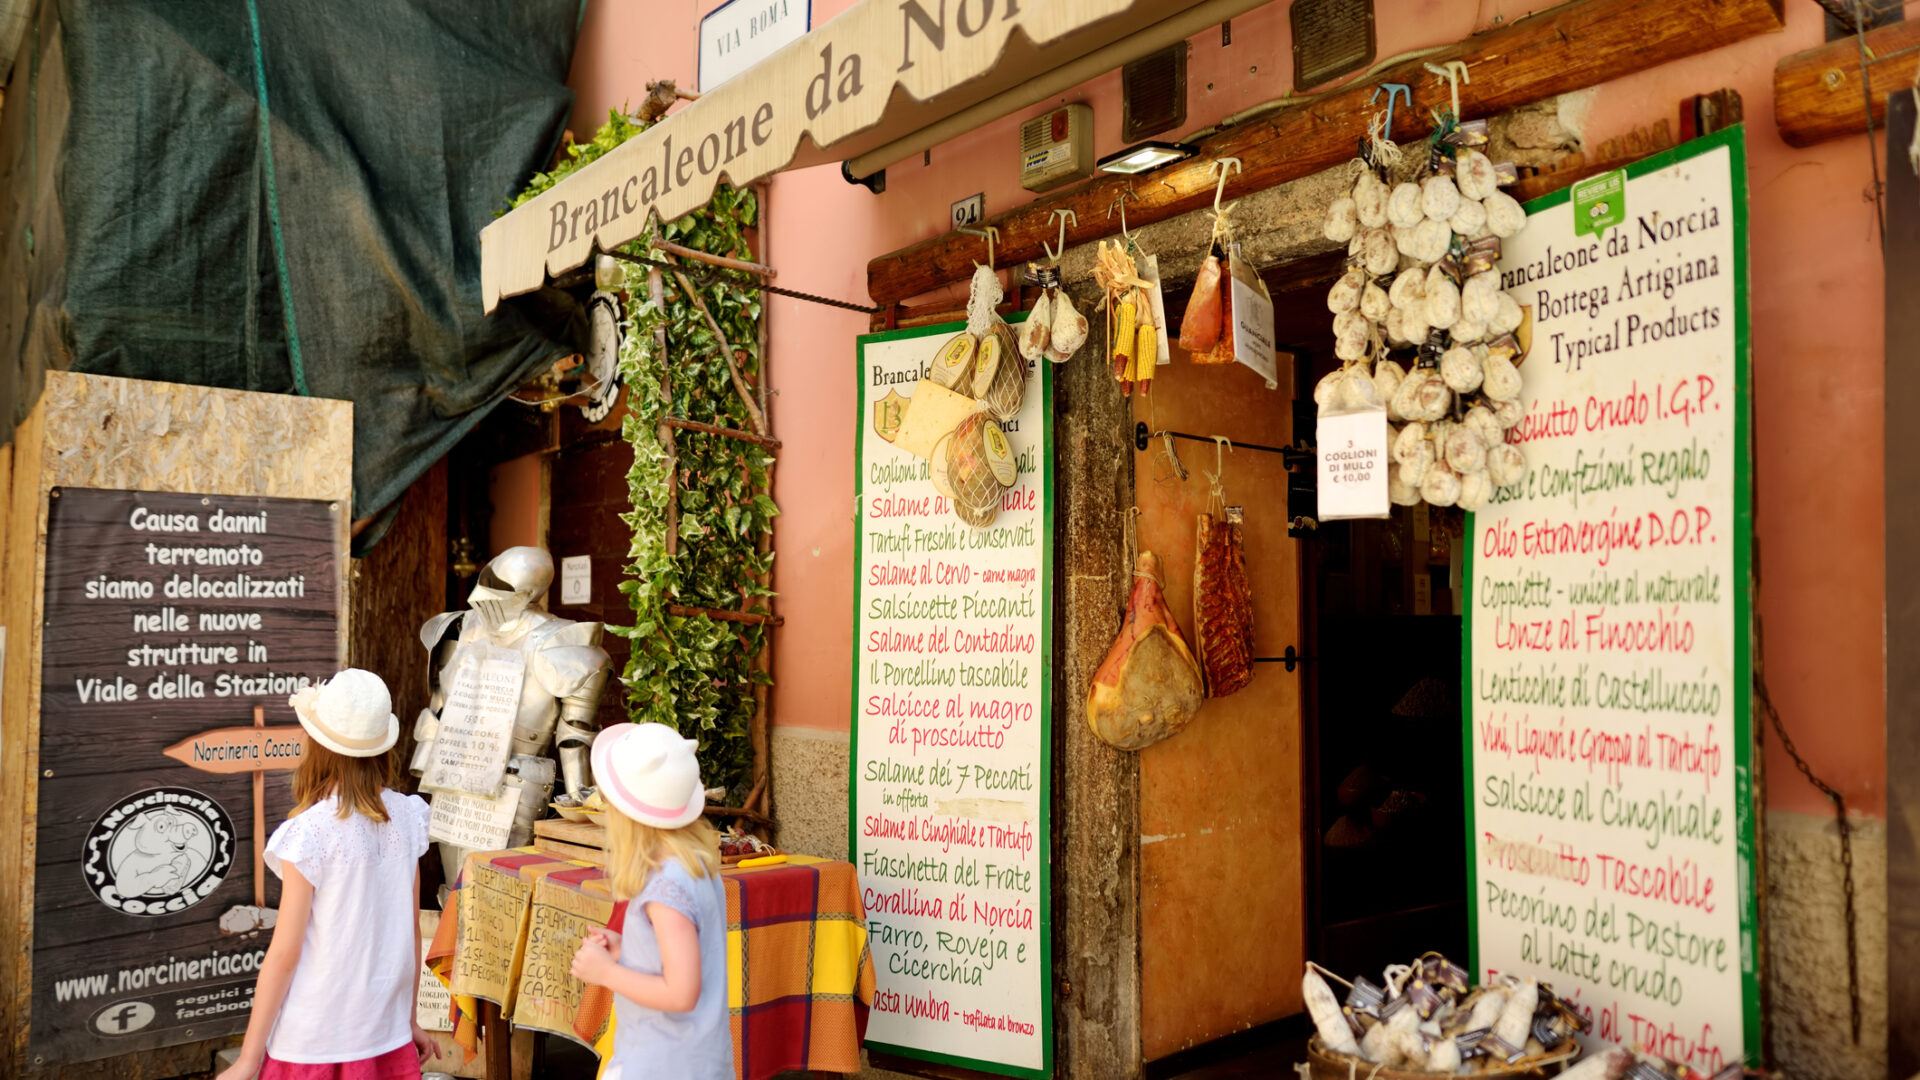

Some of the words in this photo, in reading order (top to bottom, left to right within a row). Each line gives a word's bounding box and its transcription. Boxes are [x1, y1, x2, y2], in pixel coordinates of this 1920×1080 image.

[716, 27, 742, 58] VIA
[750, 1, 789, 40] ROMA
[547, 102, 774, 252] Brancaleone
[805, 42, 864, 120] da
[1500, 243, 1599, 291] rancaleone
[1607, 228, 1629, 258] da
[1637, 197, 1720, 250] Norcia
[1537, 284, 1609, 323] Bottega
[1617, 251, 1720, 301] Artigiana
[1550, 319, 1620, 373] Typical
[1627, 304, 1720, 347] Products
[873, 361, 931, 386] Brancale
[1585, 380, 1648, 431] Crudo
[1656, 374, 1720, 427] I.G.P.
[1325, 449, 1377, 462] COGLIONI
[1347, 440, 1354, 448] 3
[871, 455, 918, 493] Coglioni
[920, 458, 931, 481] di
[1329, 463, 1342, 473] DI
[1343, 461, 1374, 472] MULO
[1343, 472, 1371, 483] 10,00
[1528, 470, 1535, 500] e
[1641, 437, 1710, 499] Regalo
[130, 507, 199, 534] Causa
[208, 509, 267, 534] danni
[870, 493, 929, 518] Salame
[935, 496, 950, 515] al
[145, 542, 263, 566] terremoto
[869, 523, 912, 561] Tartufi
[915, 521, 957, 553] Freschi
[959, 531, 965, 550] e
[969, 518, 1035, 551] Conservati
[1484, 517, 1517, 558] Olio
[1524, 506, 1642, 566] Extravergine
[1648, 506, 1716, 546] D.O.P.
[85, 576, 154, 600] siamo
[164, 574, 305, 599] delocalizzati
[868, 560, 917, 586] Salame
[920, 558, 933, 585] al
[936, 561, 970, 585] Cervo
[982, 568, 1005, 583] carne
[1007, 567, 1036, 589] magra
[1570, 569, 1620, 605] uniche
[1625, 569, 1640, 603] al
[1646, 566, 1720, 604] naturale
[134, 607, 189, 632] nelle
[200, 611, 262, 631] nuove
[868, 591, 958, 620] Salsiccette
[962, 589, 1036, 619] Piccanti
[867, 626, 923, 654] Salame
[928, 624, 950, 654] del
[954, 623, 1035, 654] Contadino
[1496, 616, 1552, 652] Lonze
[1560, 609, 1579, 650] al
[1586, 605, 1694, 654] Finocchio
[127, 644, 238, 667] strutture
[249, 641, 267, 663] in
[870, 659, 880, 685] Il
[884, 658, 956, 688] Porcellino
[960, 658, 1028, 689] tascabile
[76, 677, 137, 703] Viale
[148, 673, 205, 699] della
[214, 673, 310, 697] Stazione
[1481, 662, 1565, 707] Lenticchie
[1571, 664, 1590, 707] di
[1597, 666, 1721, 716] Castelluccio
[865, 690, 940, 719] Salcicce
[946, 693, 964, 718] al
[970, 700, 1033, 729] magro
[194, 740, 259, 763] Norcineria
[264, 737, 300, 758] Coccia
[888, 718, 907, 744] di
[912, 720, 1004, 756] prosciutto
[1516, 713, 1564, 775] Liquori
[1570, 729, 1576, 763] e
[1580, 727, 1632, 788] Grappa
[1637, 724, 1651, 768] al
[1656, 723, 1721, 794] Tartufo
[864, 757, 924, 786] Salame
[929, 757, 952, 787] dei
[956, 764, 970, 794] 7
[974, 762, 1033, 791] Peccati
[101, 791, 220, 829] Norcineria
[883, 787, 895, 805] in
[896, 788, 928, 813] offerta
[1483, 771, 1565, 820] Salsicce
[1574, 780, 1594, 821] al
[1602, 780, 1722, 850] Cinghiale
[863, 812, 905, 841] Salame
[908, 815, 919, 841] al
[922, 815, 977, 853] Cinghiale
[979, 830, 985, 848] e
[987, 820, 1033, 861] Tartufo
[863, 848, 948, 883] Fiaschetta
[954, 856, 980, 887] del
[985, 864, 1032, 893] Frate
[1596, 854, 1715, 914] Tascabile
[100, 874, 223, 915] Coccia
[864, 888, 943, 919] Corallina
[949, 892, 968, 922] di
[974, 899, 1033, 930] Norcia
[869, 921, 929, 953] Farro,
[936, 929, 1007, 970] Roveja
[1017, 942, 1027, 964] e
[1486, 880, 1577, 933] Pecorino
[1585, 897, 1620, 943] del
[1627, 912, 1728, 973] Pastore
[55, 950, 265, 1003] www.norcineriacoc
[889, 950, 982, 986] Cicerchia
[1522, 927, 1542, 965] al
[1550, 931, 1602, 984] latte
[1609, 956, 1682, 1007] crudo
[176, 987, 239, 1006] seguici
[873, 988, 900, 1014] asta
[904, 990, 950, 1022] umbra
[963, 1009, 996, 1032] trafilata
[997, 1015, 1006, 1031] al
[1007, 1015, 1035, 1037] bronzo
[1600, 1001, 1622, 1044] al
[1627, 1013, 1726, 1078] Tartufo
